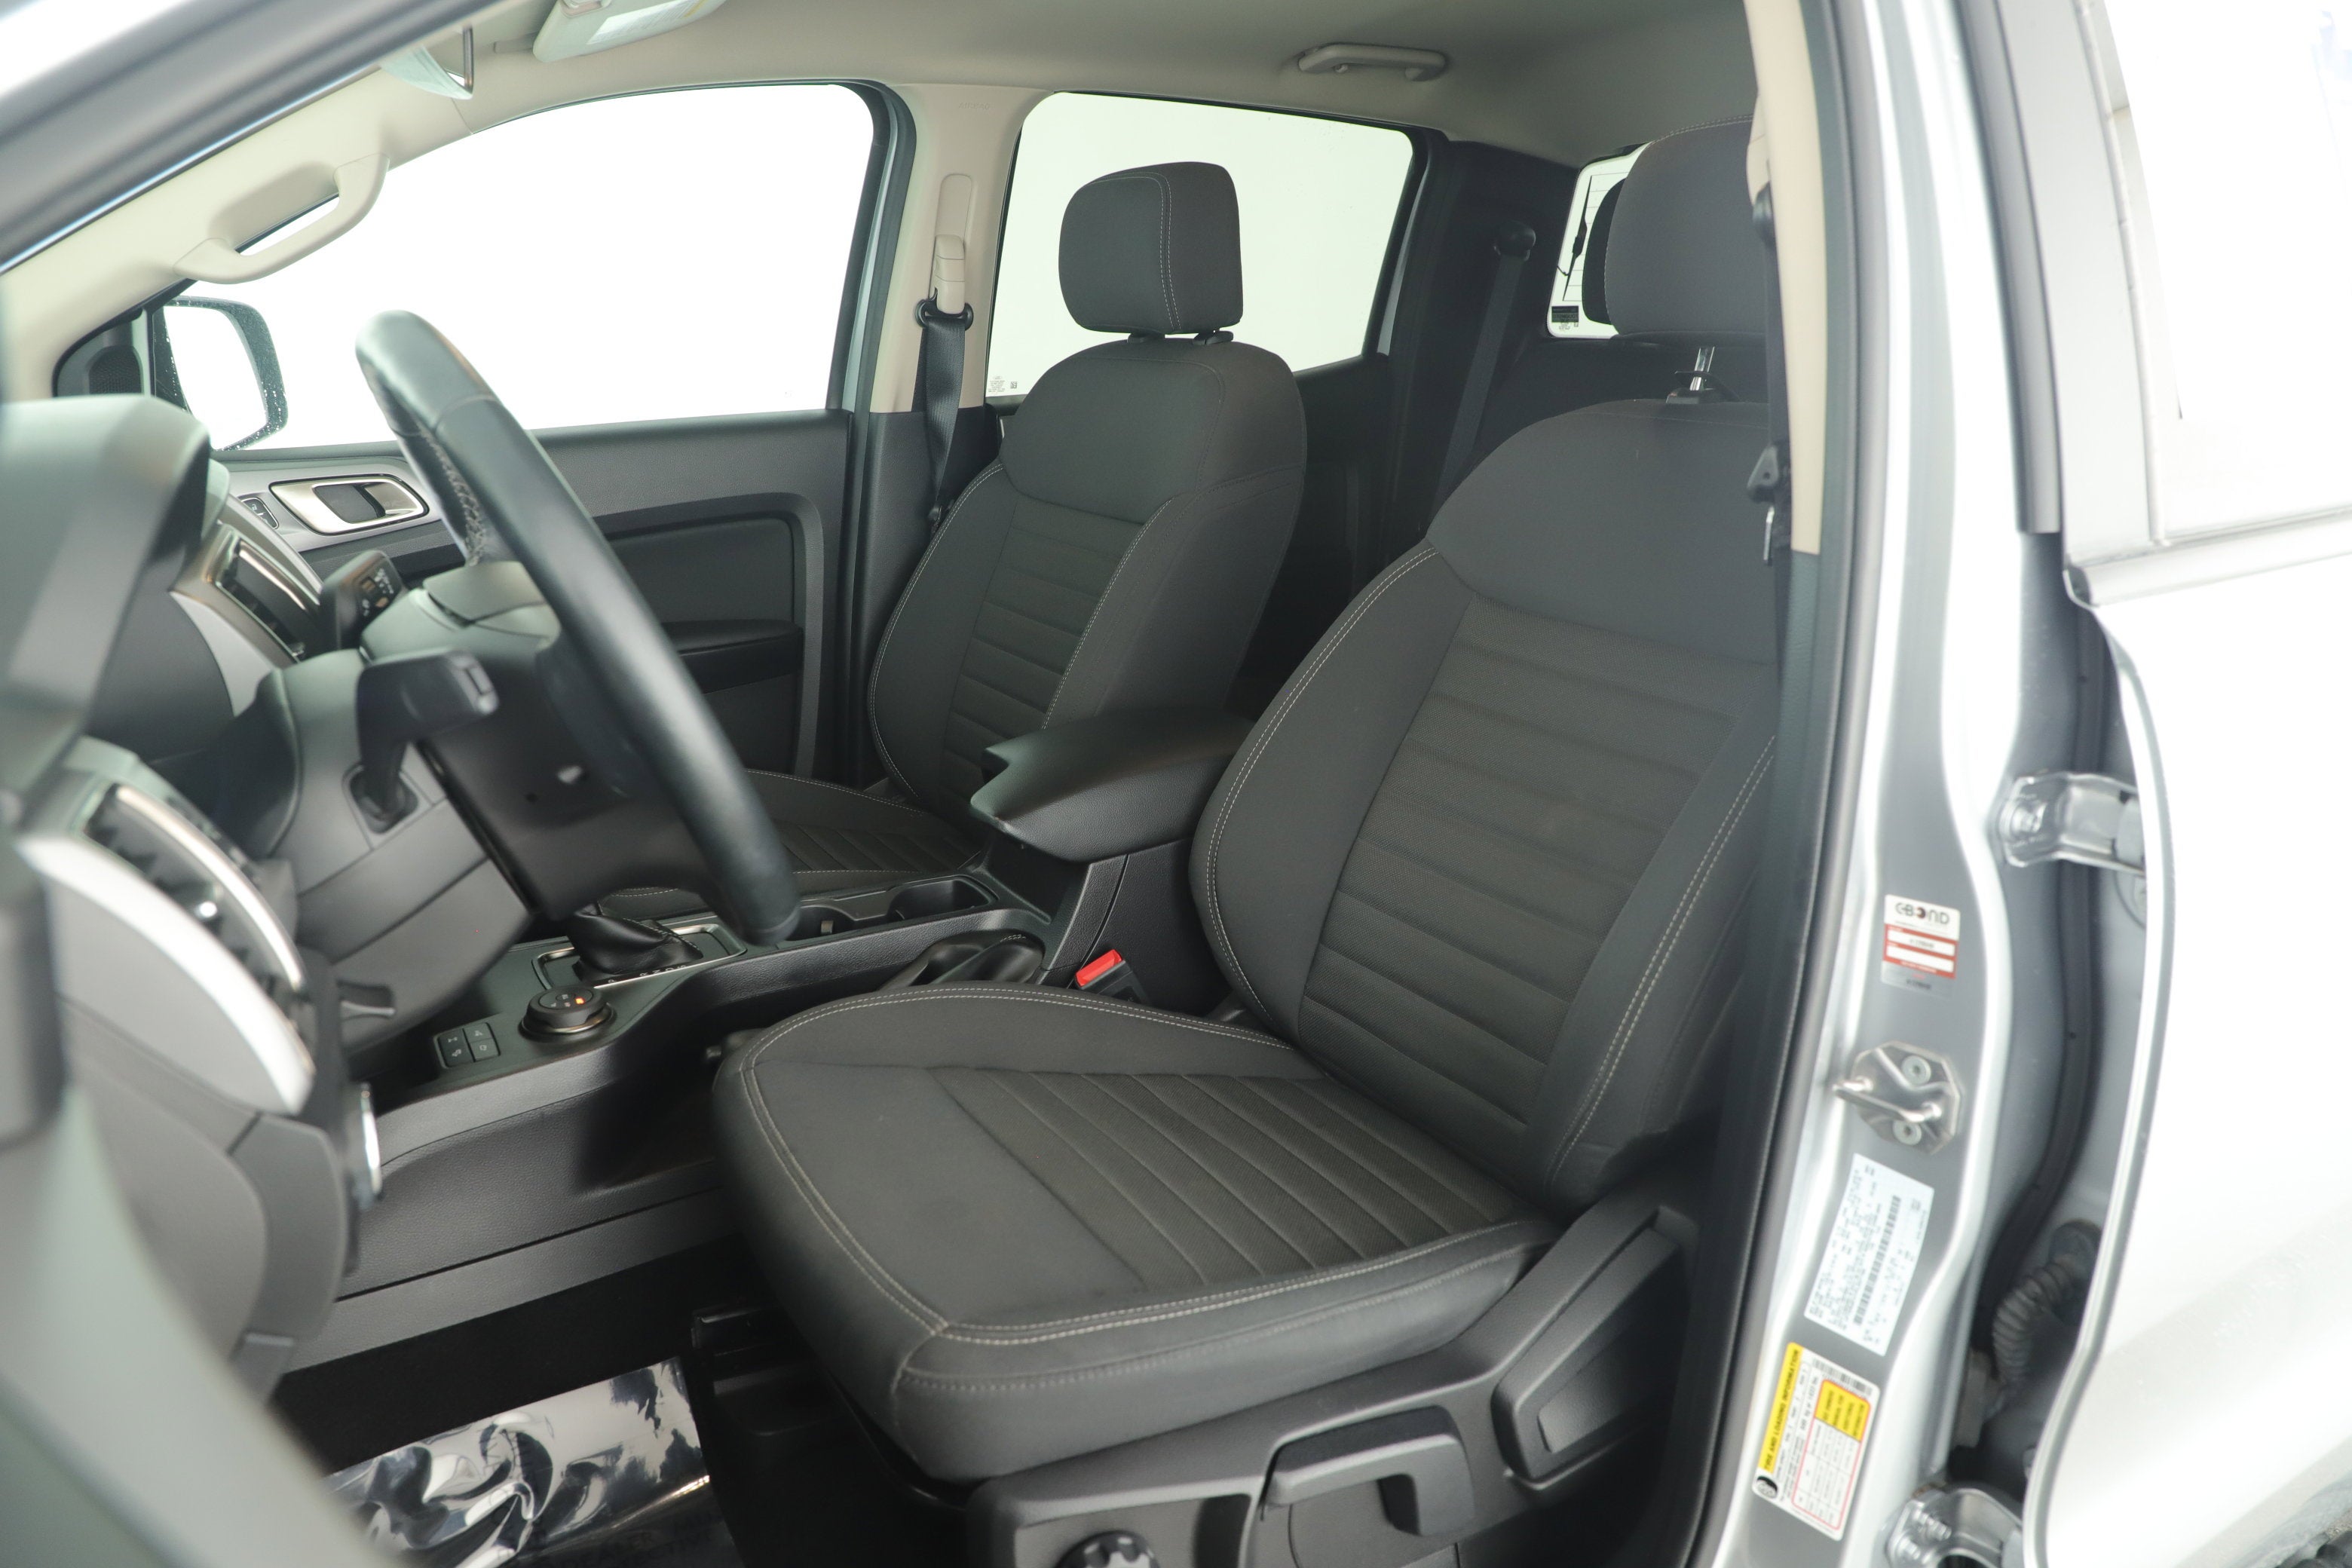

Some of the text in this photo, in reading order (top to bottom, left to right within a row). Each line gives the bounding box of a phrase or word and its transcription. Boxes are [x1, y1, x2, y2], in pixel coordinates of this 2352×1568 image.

[1783, 1348, 1799, 1402] INFORMATION
[1773, 1402, 1787, 1435] LOADING
[1769, 1435, 1778, 1452] AND
[1765, 1453, 1773, 1470] TIRE
